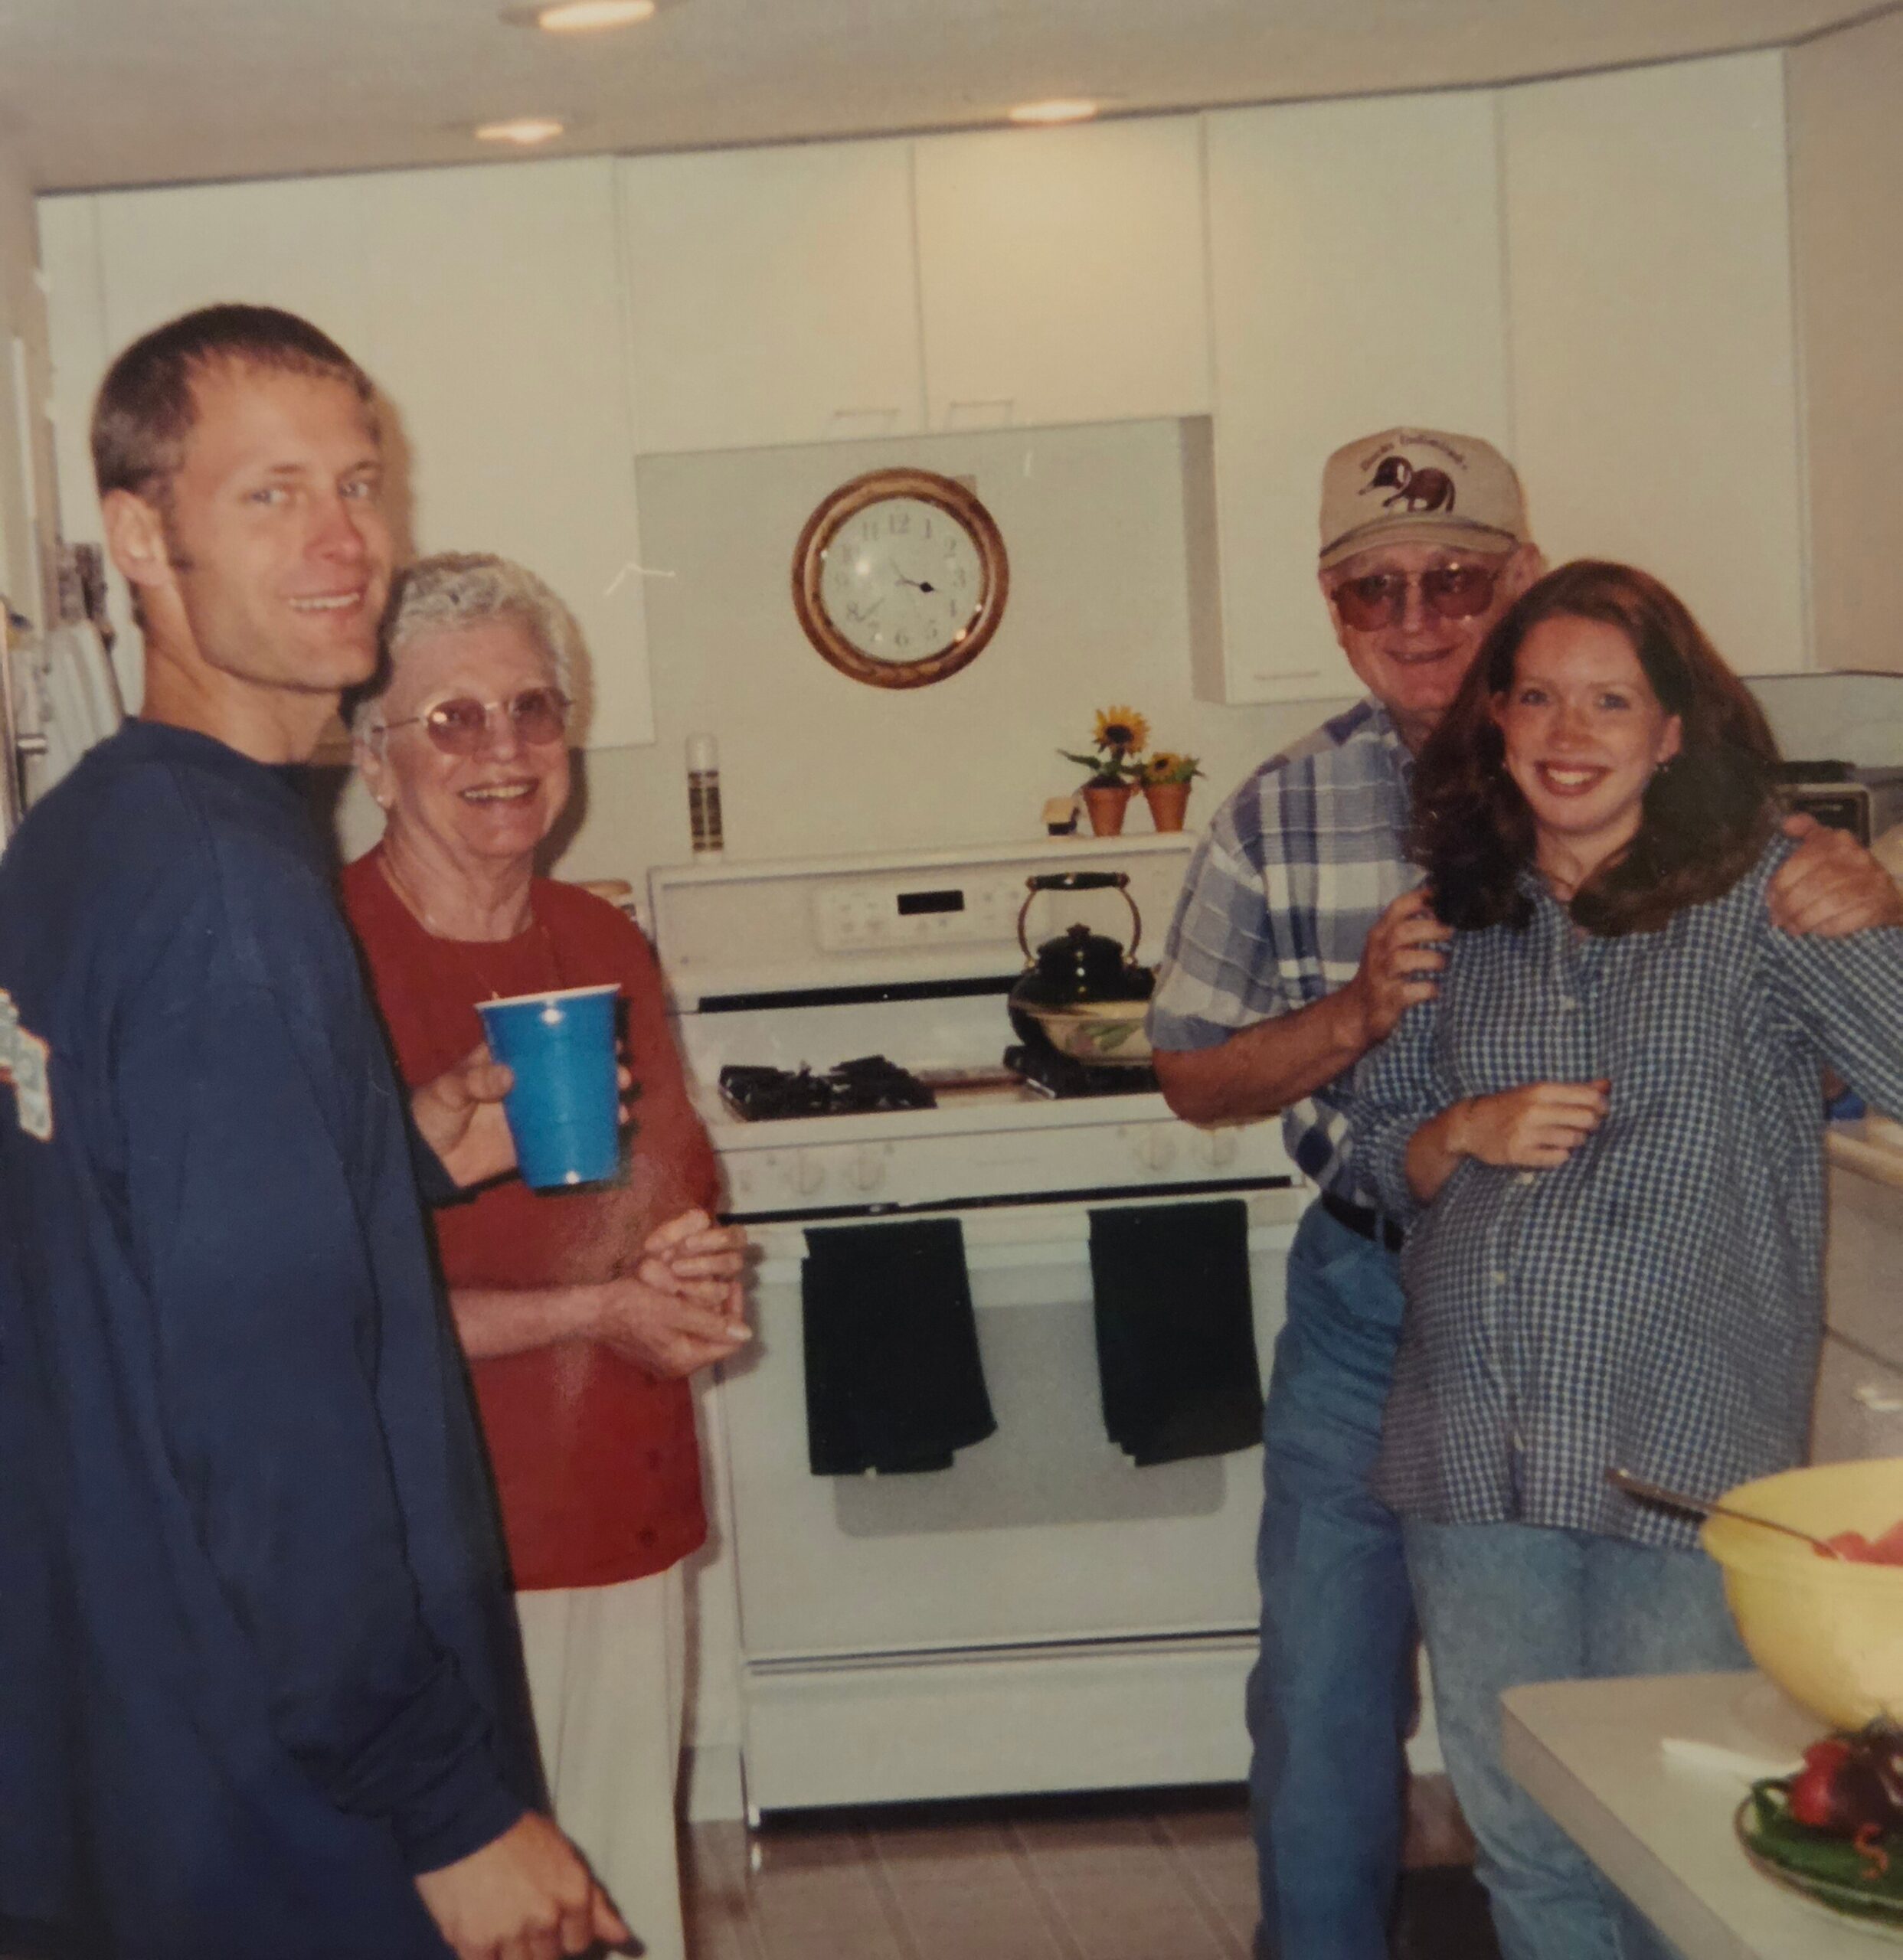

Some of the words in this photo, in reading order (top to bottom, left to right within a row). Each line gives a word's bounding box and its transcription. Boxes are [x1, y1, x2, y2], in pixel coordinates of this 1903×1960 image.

[862, 521, 879, 541] 11
[889, 514, 910, 534] 12
[943, 537, 957, 558] 2
[894, 629, 910, 647] 6
